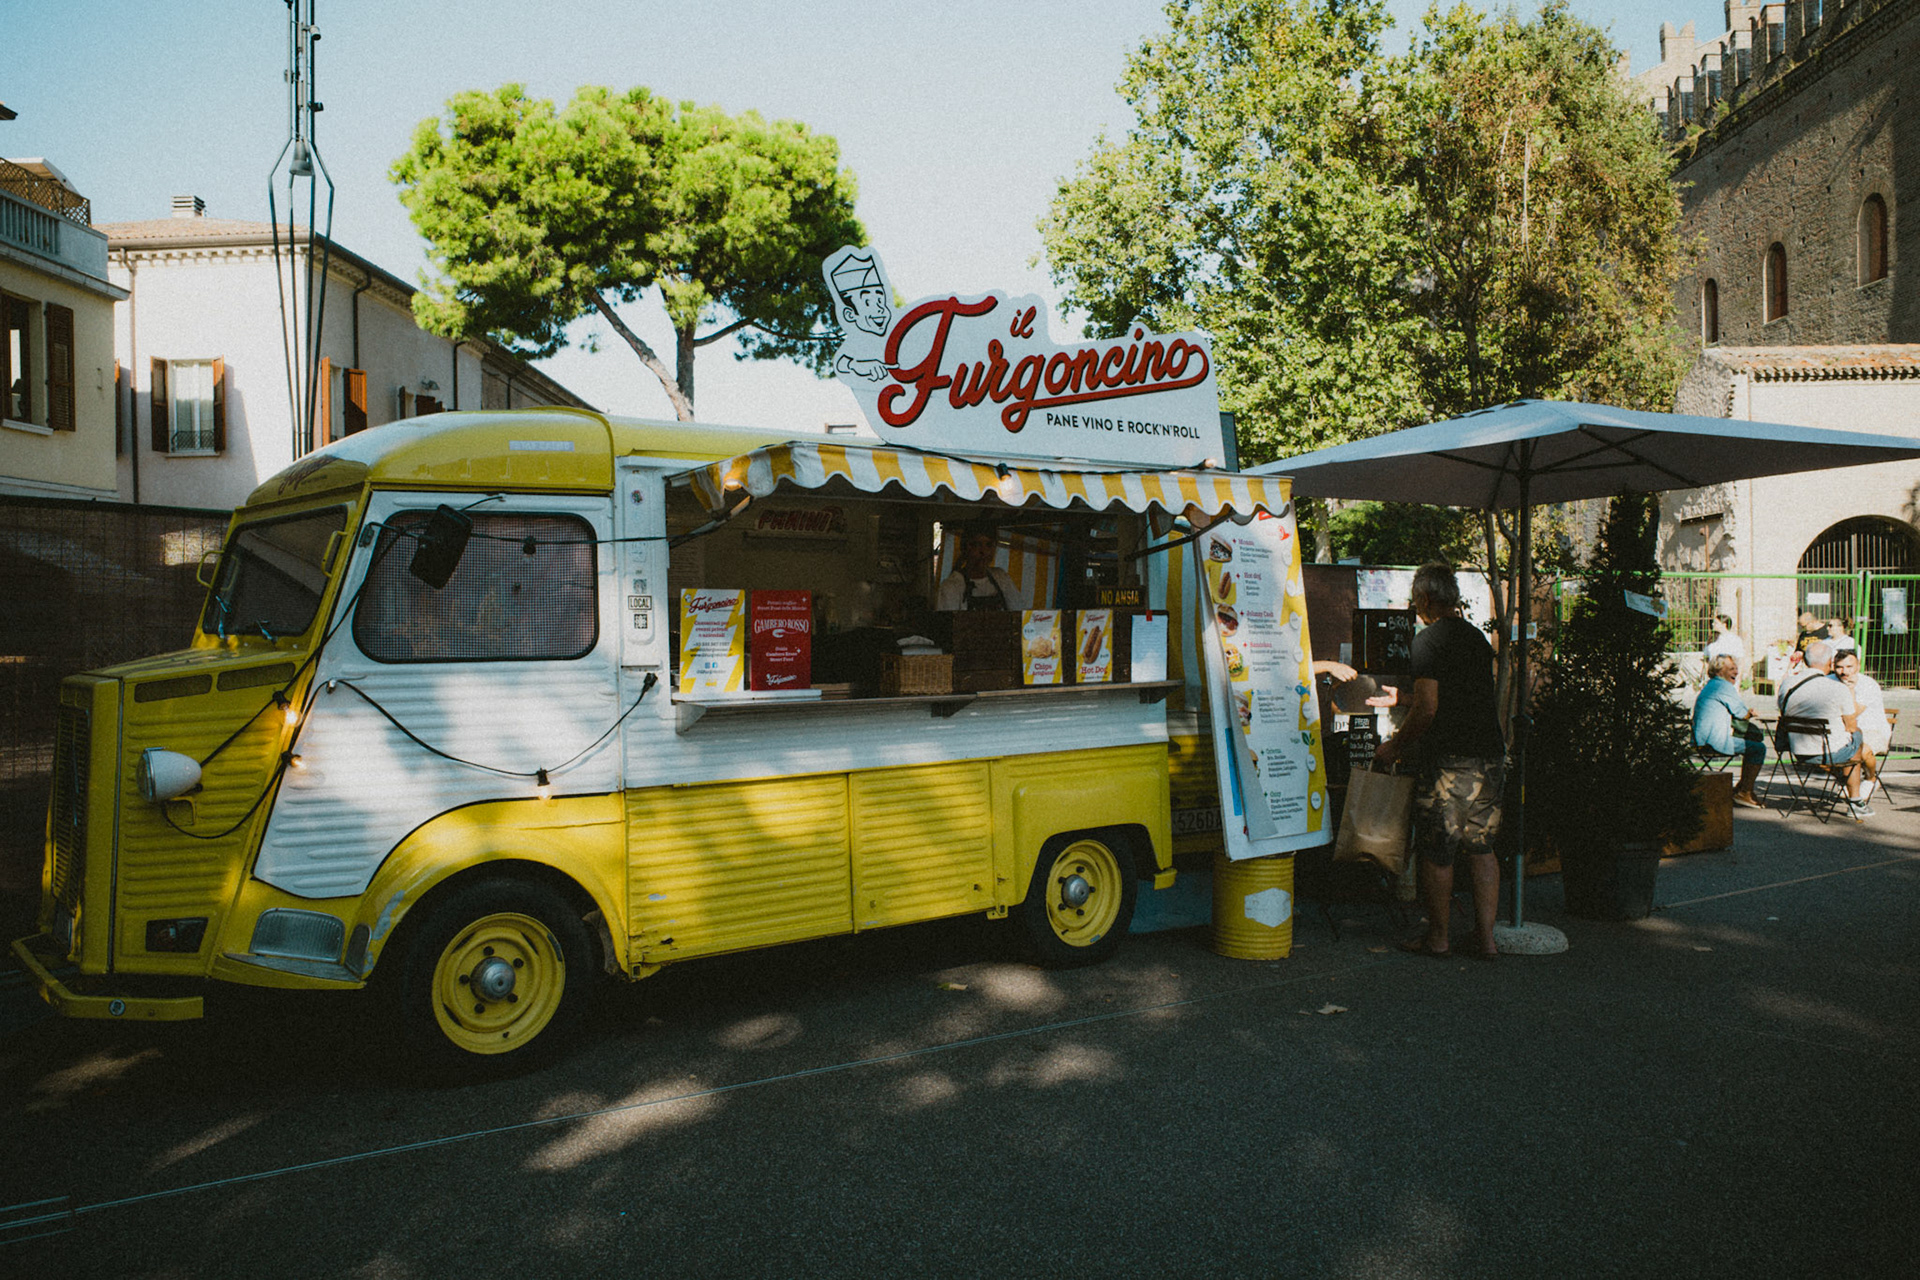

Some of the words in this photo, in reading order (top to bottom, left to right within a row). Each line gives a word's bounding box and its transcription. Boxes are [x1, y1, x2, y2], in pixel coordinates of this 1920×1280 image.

[1009, 305, 1037, 340] il
[877, 295, 1209, 433] Furgoncino
[1046, 412, 1079, 428] PANE
[1082, 416, 1113, 431] VINO
[1117, 420, 1124, 432] E
[1128, 421, 1200, 439] ROCK'N'ROLL
[630, 597, 650, 608] LOCAL
[1101, 589, 1113, 605] NO
[1115, 589, 1139, 605] ANSIA
[754, 619, 787, 634] GAMBERO
[787, 619, 809, 634] ROSSO
[1081, 666, 1094, 674] Hot
[1095, 665, 1108, 675] Dog
